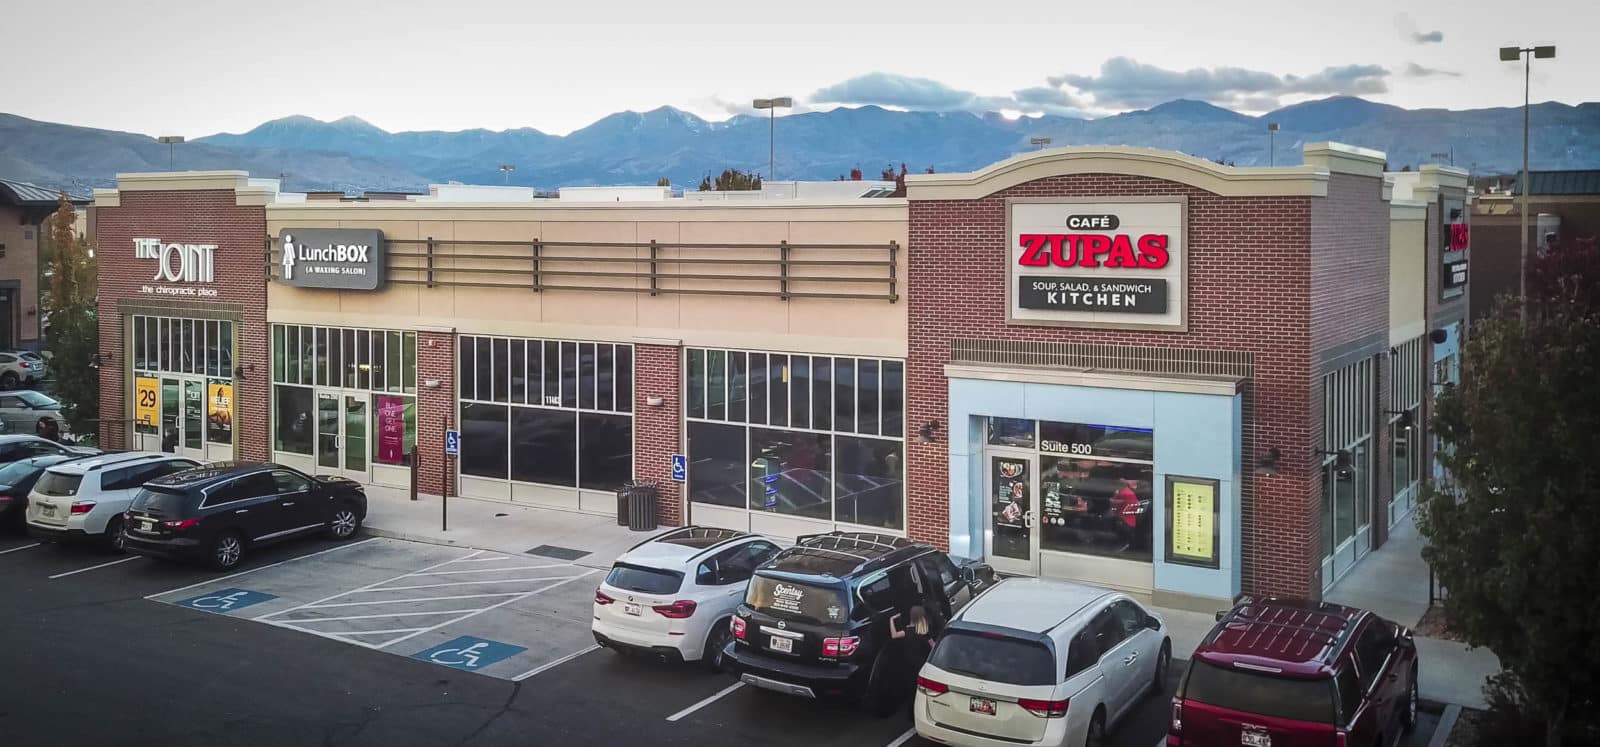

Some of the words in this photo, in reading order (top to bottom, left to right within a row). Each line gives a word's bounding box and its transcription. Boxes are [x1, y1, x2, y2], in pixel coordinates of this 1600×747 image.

[1069, 216, 1110, 228] CAFÉ
[133, 238, 161, 259] THE
[299, 243, 368, 262] LunchBOX
[1018, 234, 1169, 269] ZUPAS
[154, 243, 218, 282] JOINT
[314, 266, 339, 274] WAXING
[156, 286, 196, 296] chiropractic
[198, 287, 218, 297] place
[1101, 283, 1152, 294] SANDWICH
[1047, 292, 1136, 307] KITCHEN
[1041, 440, 1068, 452] Suite
[1071, 443, 1092, 454] 500
[773, 583, 804, 600] Scentsy
